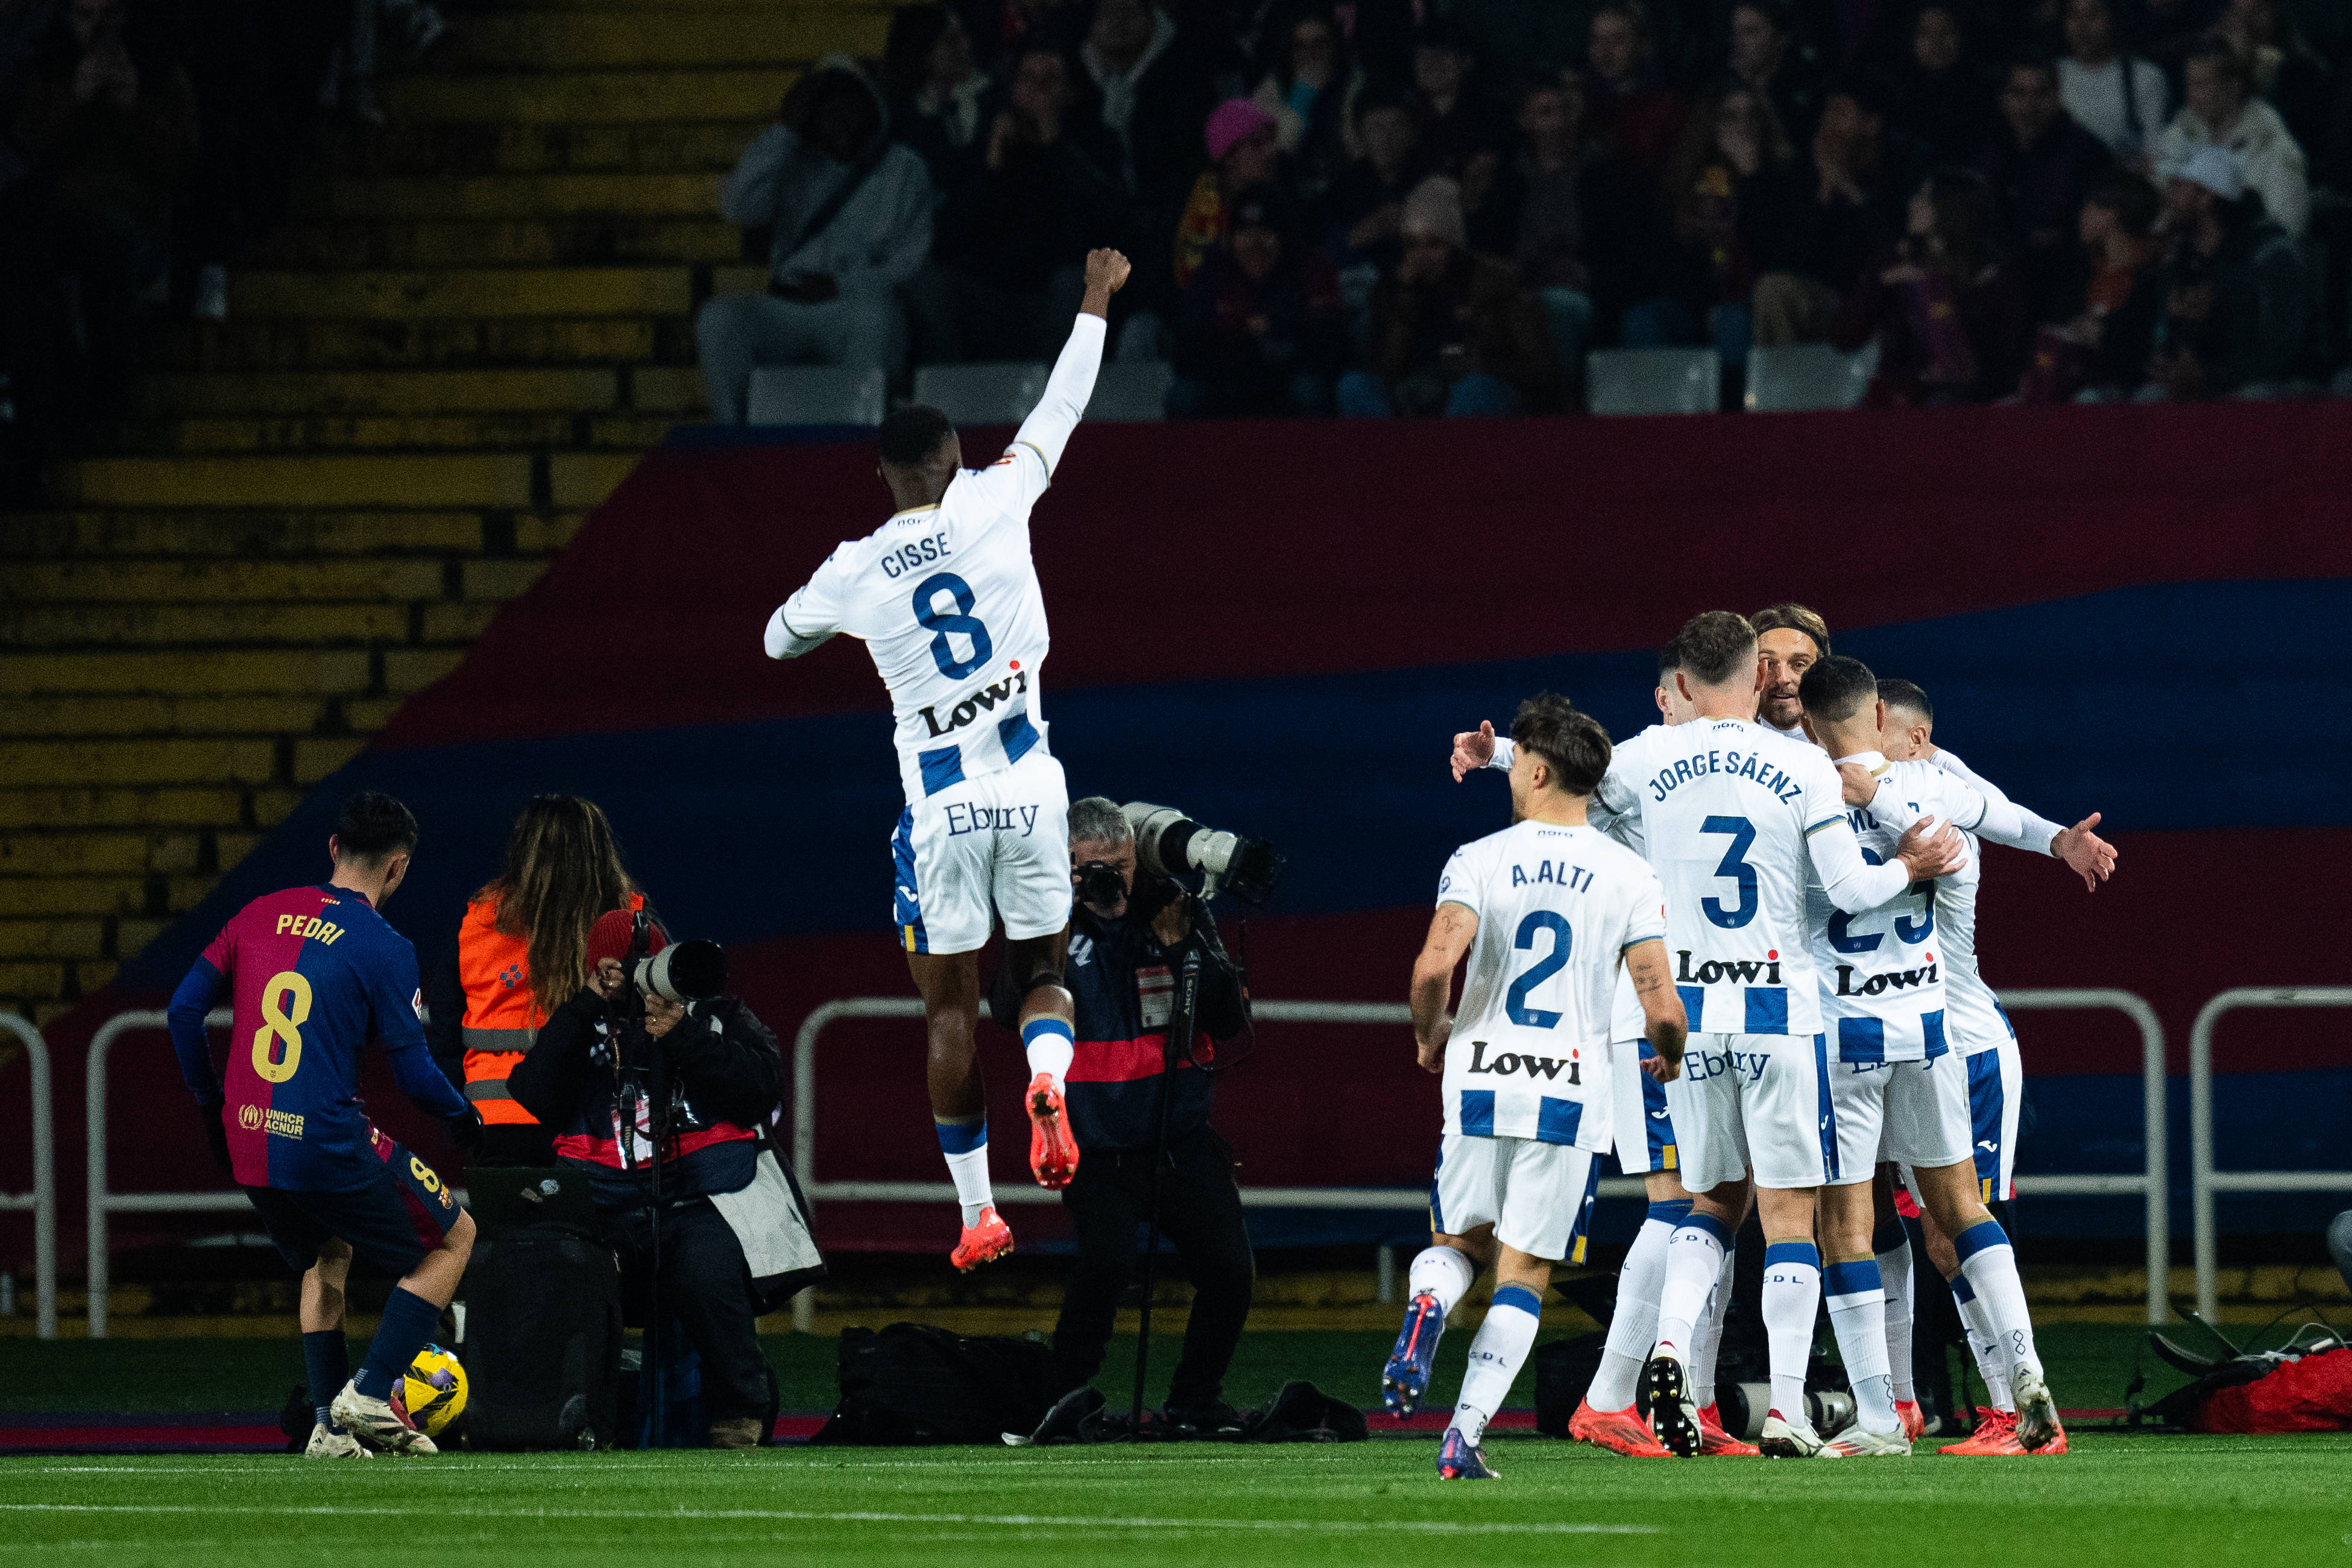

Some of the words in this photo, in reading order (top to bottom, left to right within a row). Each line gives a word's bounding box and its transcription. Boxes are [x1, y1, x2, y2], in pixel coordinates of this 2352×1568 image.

[881, 532, 951, 579] CISSE
[912, 572, 992, 681] 8
[918, 660, 1027, 738] Lowi
[1648, 750, 1721, 802] JORGE
[1724, 751, 1802, 805] SÁENZ
[943, 802, 1039, 837] Ebury
[1512, 860, 1594, 894] A.ALTI
[1699, 815, 1758, 929] 3
[1827, 846, 1937, 954] 23
[276, 914, 345, 946] PEDRI
[1505, 910, 1573, 1030] 2
[1675, 948, 1782, 985] Lowi
[1834, 951, 1940, 997] Lowi
[1184, 978, 1193, 1016] SONY
[251, 970, 313, 1084] 8
[1467, 1041, 1581, 1086] Lowi
[263, 1119, 303, 1136] ACNUR
[265, 1108, 304, 1126] UNHCR
[410, 1157, 440, 1193] 8
